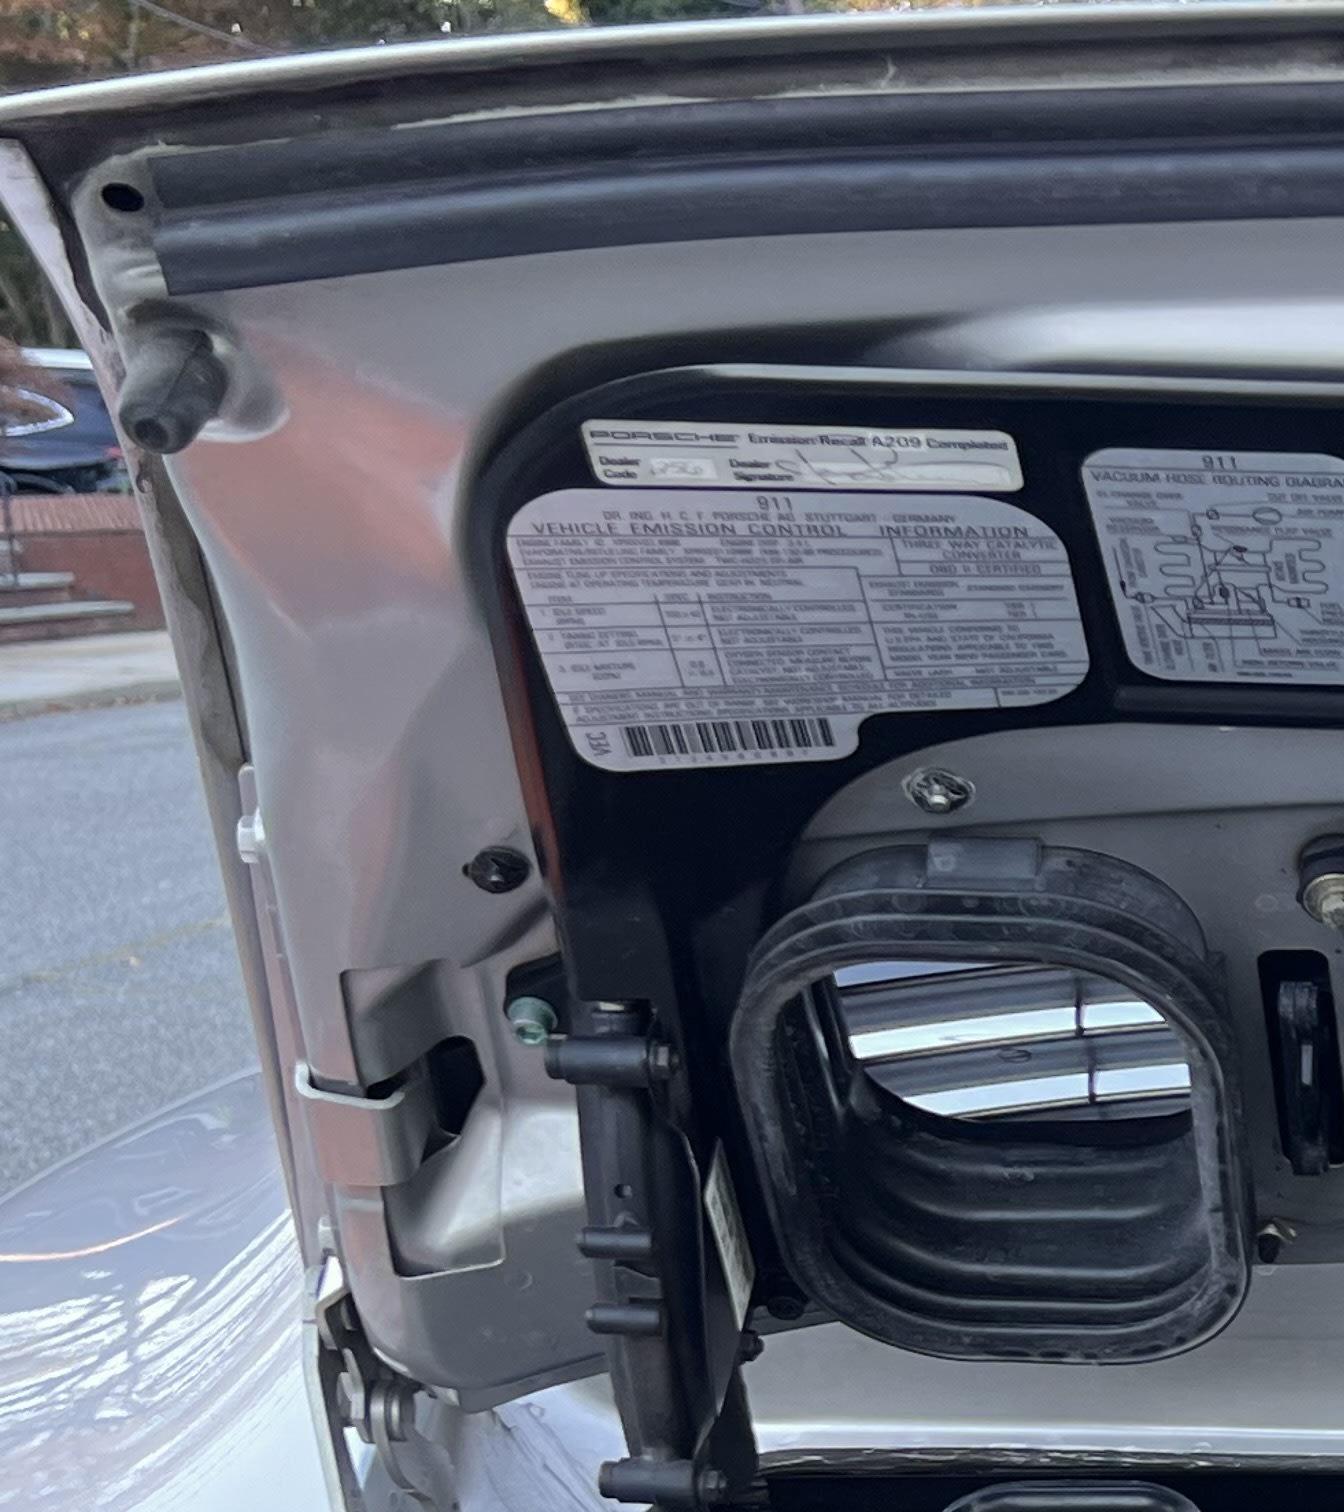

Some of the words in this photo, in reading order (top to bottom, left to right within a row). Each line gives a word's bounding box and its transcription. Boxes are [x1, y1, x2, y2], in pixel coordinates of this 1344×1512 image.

[590, 430, 739, 442] PORSCHE
[748, 433, 817, 445] Emission
[818, 435, 866, 447] Recall
[872, 436, 922, 449] A209
[926, 439, 1008, 451] Completed
[599, 456, 641, 467] Dealer
[1202, 455, 1238, 469] 911
[603, 469, 638, 480] Code
[1090, 471, 1160, 482] VACUUM
[1166, 473, 1206, 484] HOSE
[1213, 475, 1280, 487] ROUTING
[757, 496, 793, 511] 911
[531, 523, 615, 535] VEHICLE
[630, 523, 735, 535] EMISSION
[747, 523, 847, 536] CONTROL
[879, 525, 1029, 538] INFORMATION
[901, 539, 943, 549] THREE
[949, 540, 981, 549] WAY
[986, 540, 1059, 550] CATALYTIC
[942, 550, 1021, 560] CONVERTER
[976, 564, 1041, 574] CERTIFIED
[586, 731, 612, 757] VEC
